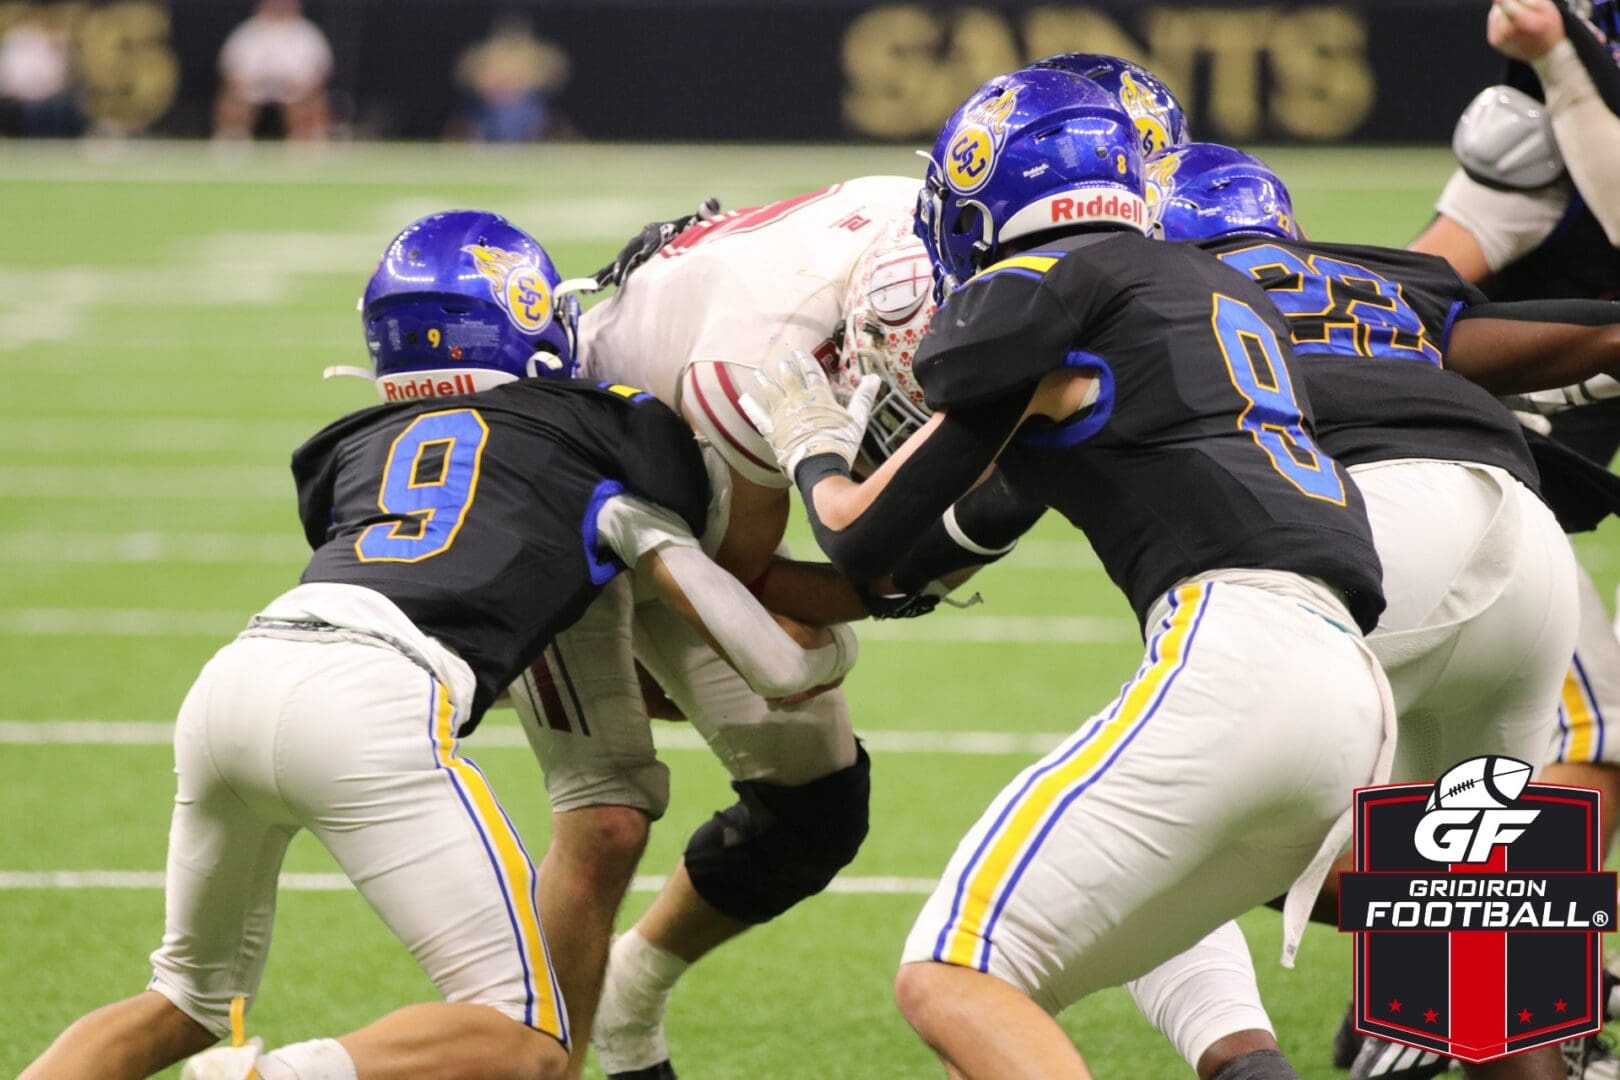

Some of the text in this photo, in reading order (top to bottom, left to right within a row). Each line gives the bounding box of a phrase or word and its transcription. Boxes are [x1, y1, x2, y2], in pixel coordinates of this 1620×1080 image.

[1115, 153, 1127, 175] 8
[1051, 194, 1143, 225] Riddell
[427, 328, 441, 348] 9
[383, 373, 476, 401] Riddell
[1212, 292, 1346, 507] 8
[354, 408, 490, 563] 9
